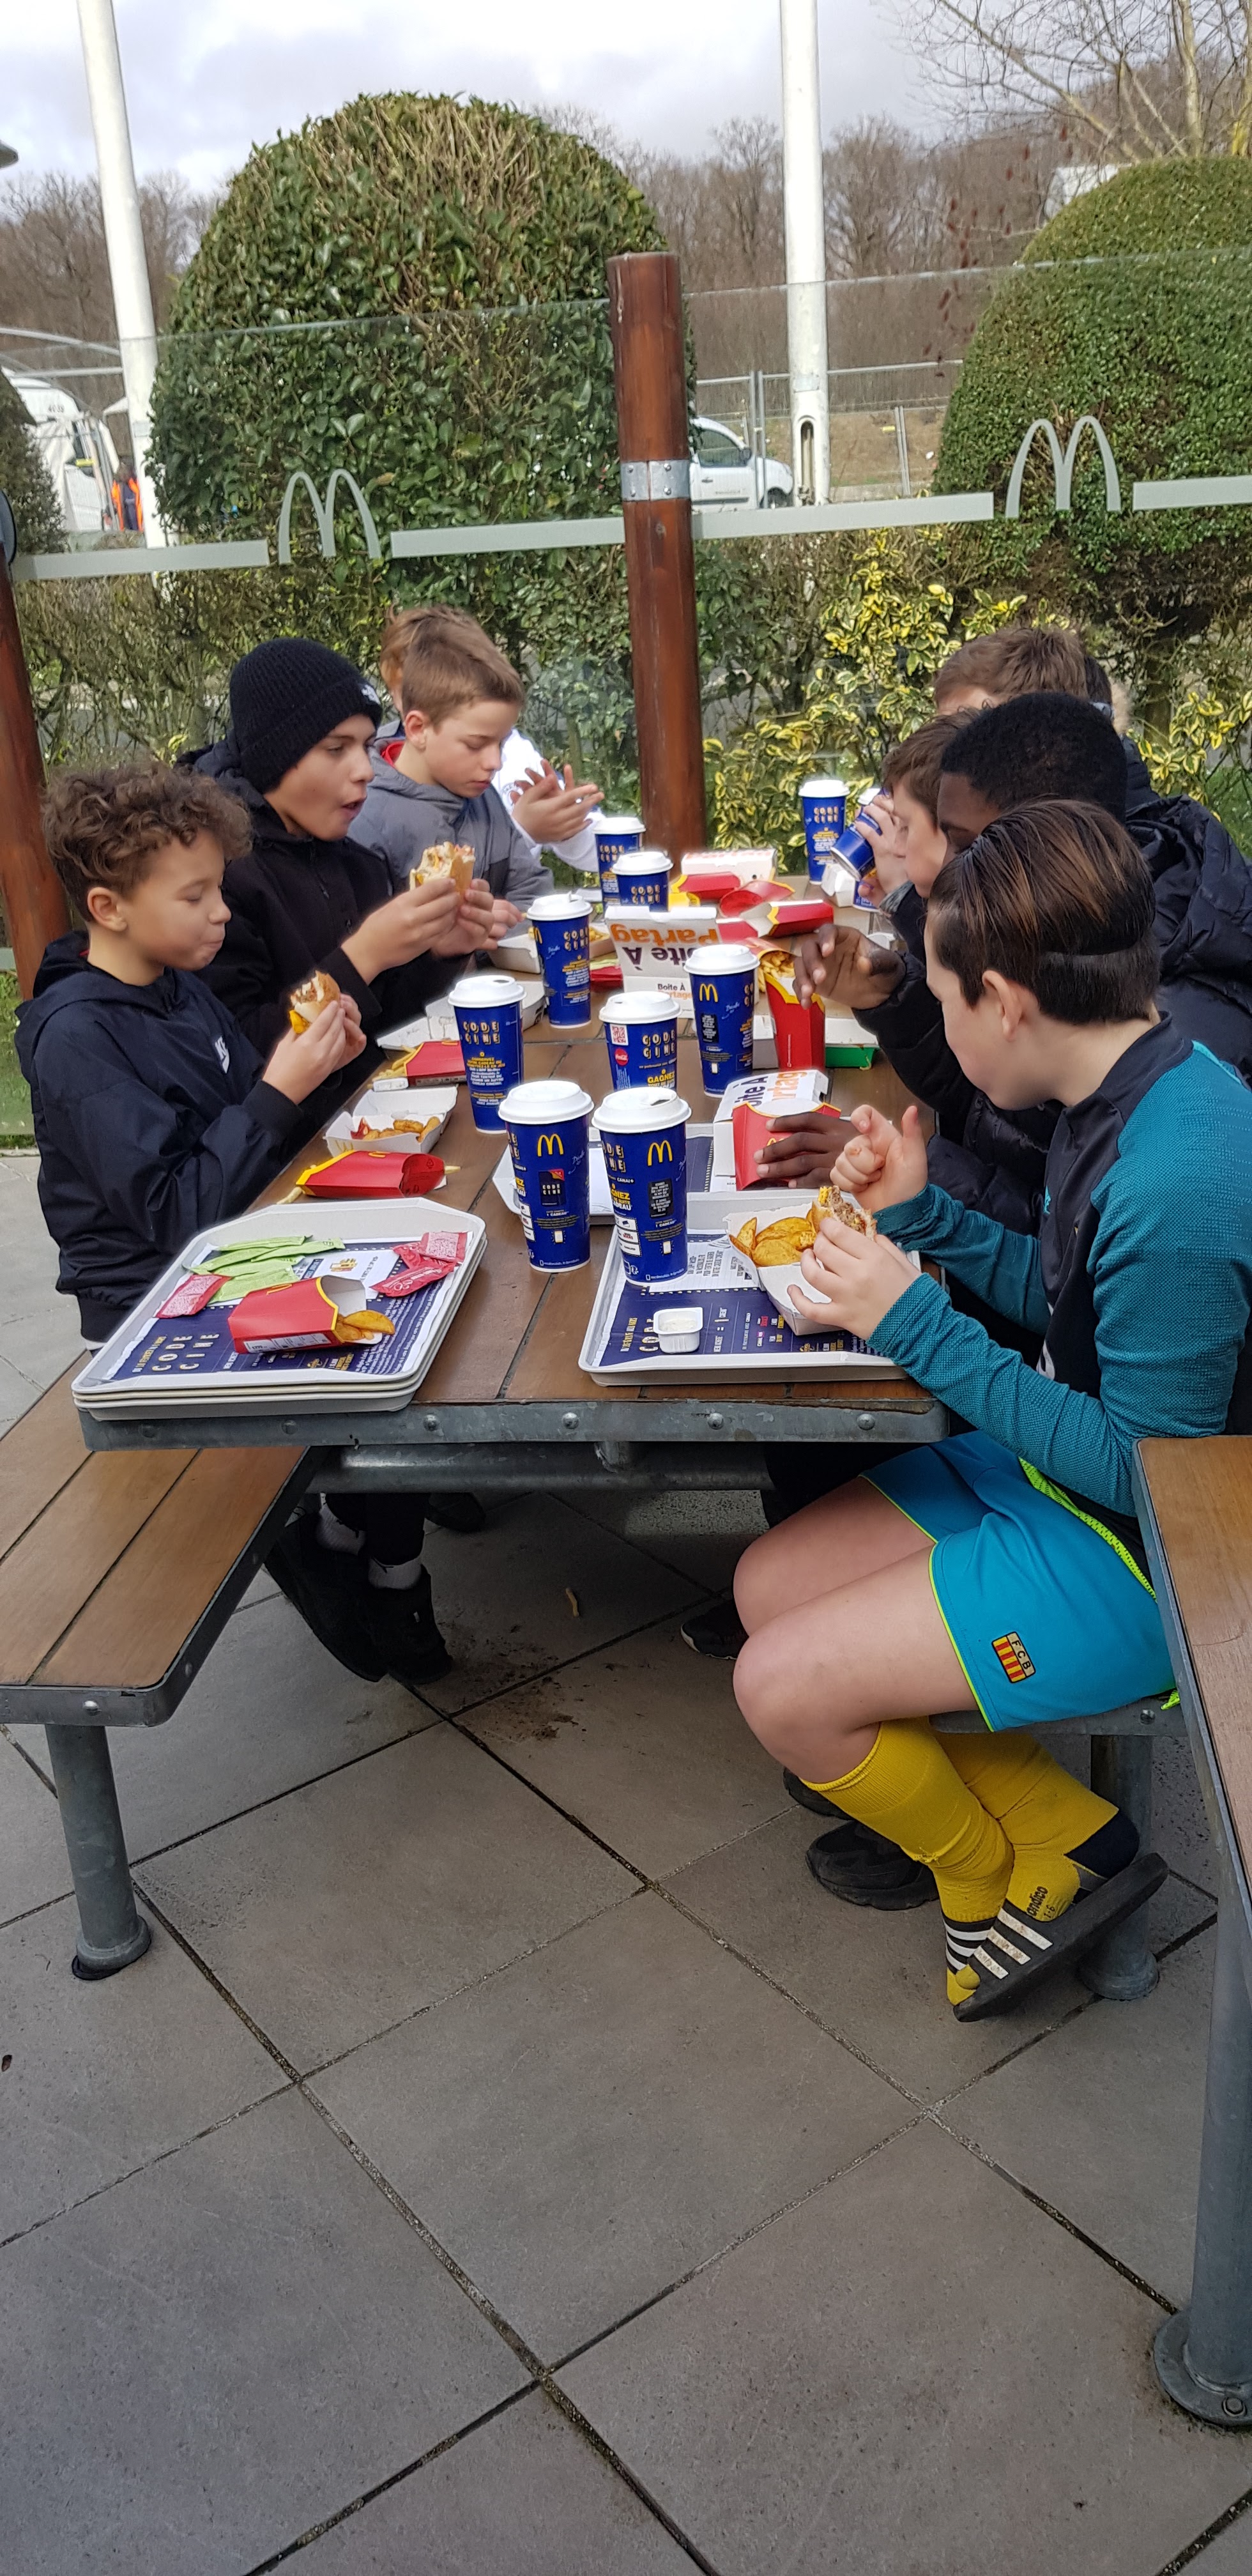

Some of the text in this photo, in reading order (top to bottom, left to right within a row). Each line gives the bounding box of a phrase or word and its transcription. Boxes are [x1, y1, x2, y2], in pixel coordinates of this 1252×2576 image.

[462, 1021, 500, 1034] CODE
[464, 1033, 501, 1045] CINE
[642, 1029, 675, 1046] CODE
[643, 1042, 675, 1059] CINE
[647, 1071, 675, 1084] GAGNEZ
[151, 1336, 192, 1372] CODE
[179, 1334, 220, 1370] CINE
[1011, 1640, 1031, 1669] FCB
